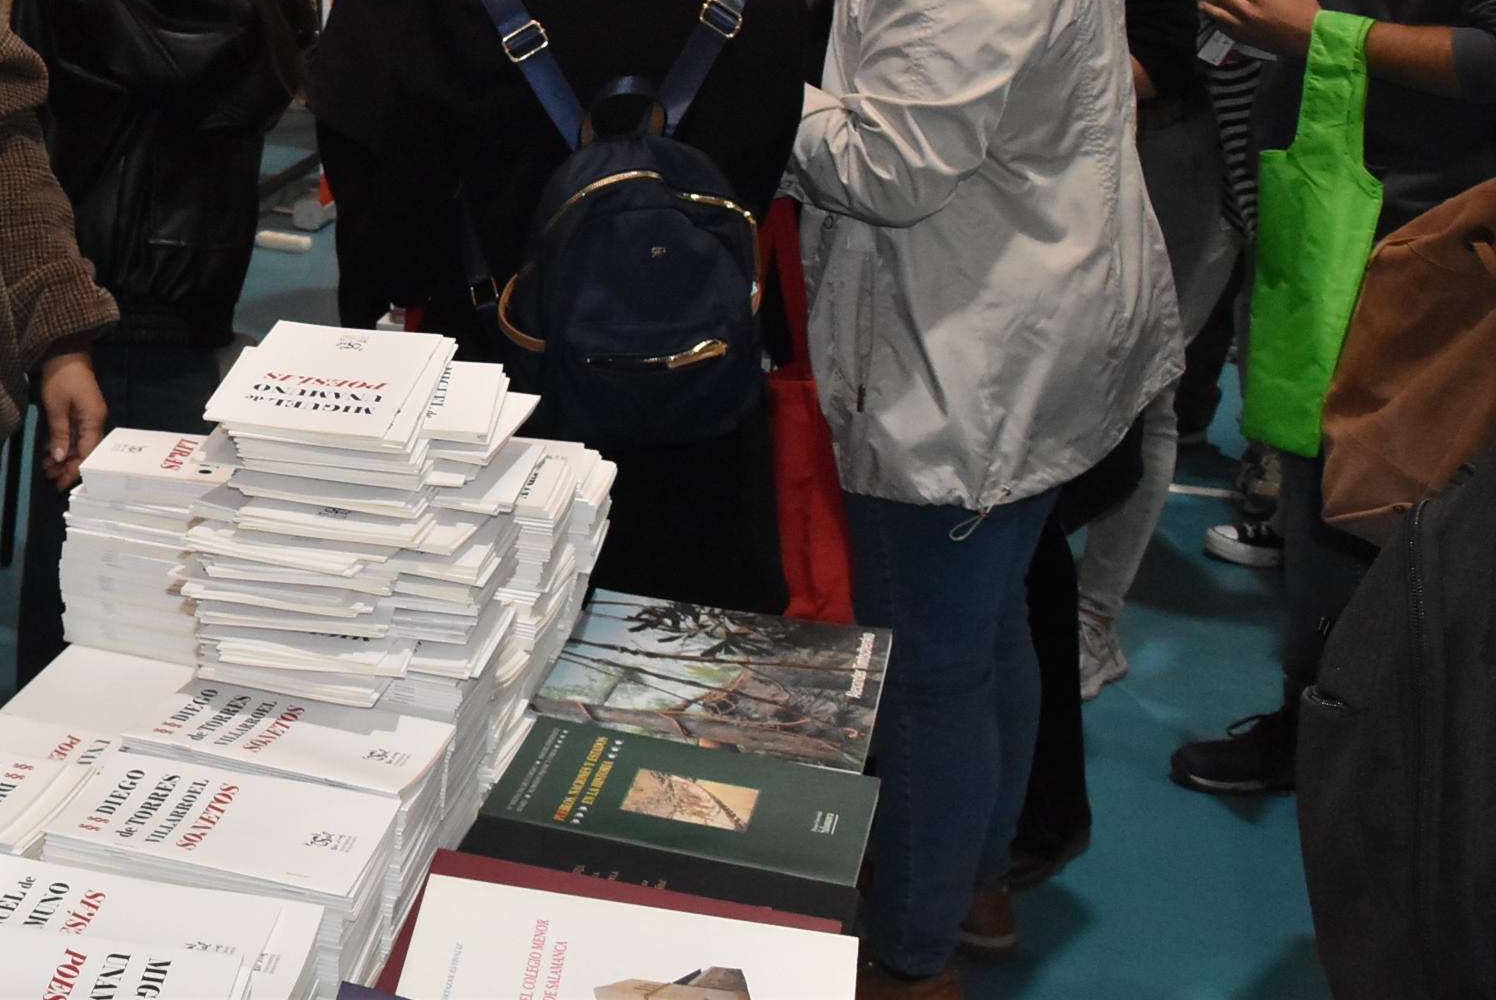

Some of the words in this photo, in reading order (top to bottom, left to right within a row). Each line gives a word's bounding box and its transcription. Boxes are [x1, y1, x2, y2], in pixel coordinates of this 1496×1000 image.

[253, 383, 383, 403] UNAMUNO
[273, 398, 376, 416] MIGUEL
[171, 688, 219, 723] DIEGO
[187, 727, 206, 742] de
[201, 694, 252, 736] TORRES
[214, 700, 277, 747] VILLARROEL
[243, 704, 305, 753] SONETOS
[95, 769, 145, 816] DIEGO
[124, 773, 182, 827] TORRES
[144, 779, 209, 843] VILLARROEL
[115, 825, 138, 839] de
[176, 783, 240, 850] SONETOS
[17, 875, 37, 890] de
[532, 918, 550, 951] MENOR
[523, 951, 544, 990] COLEGIO
[547, 940, 569, 987] SALAMANCA
